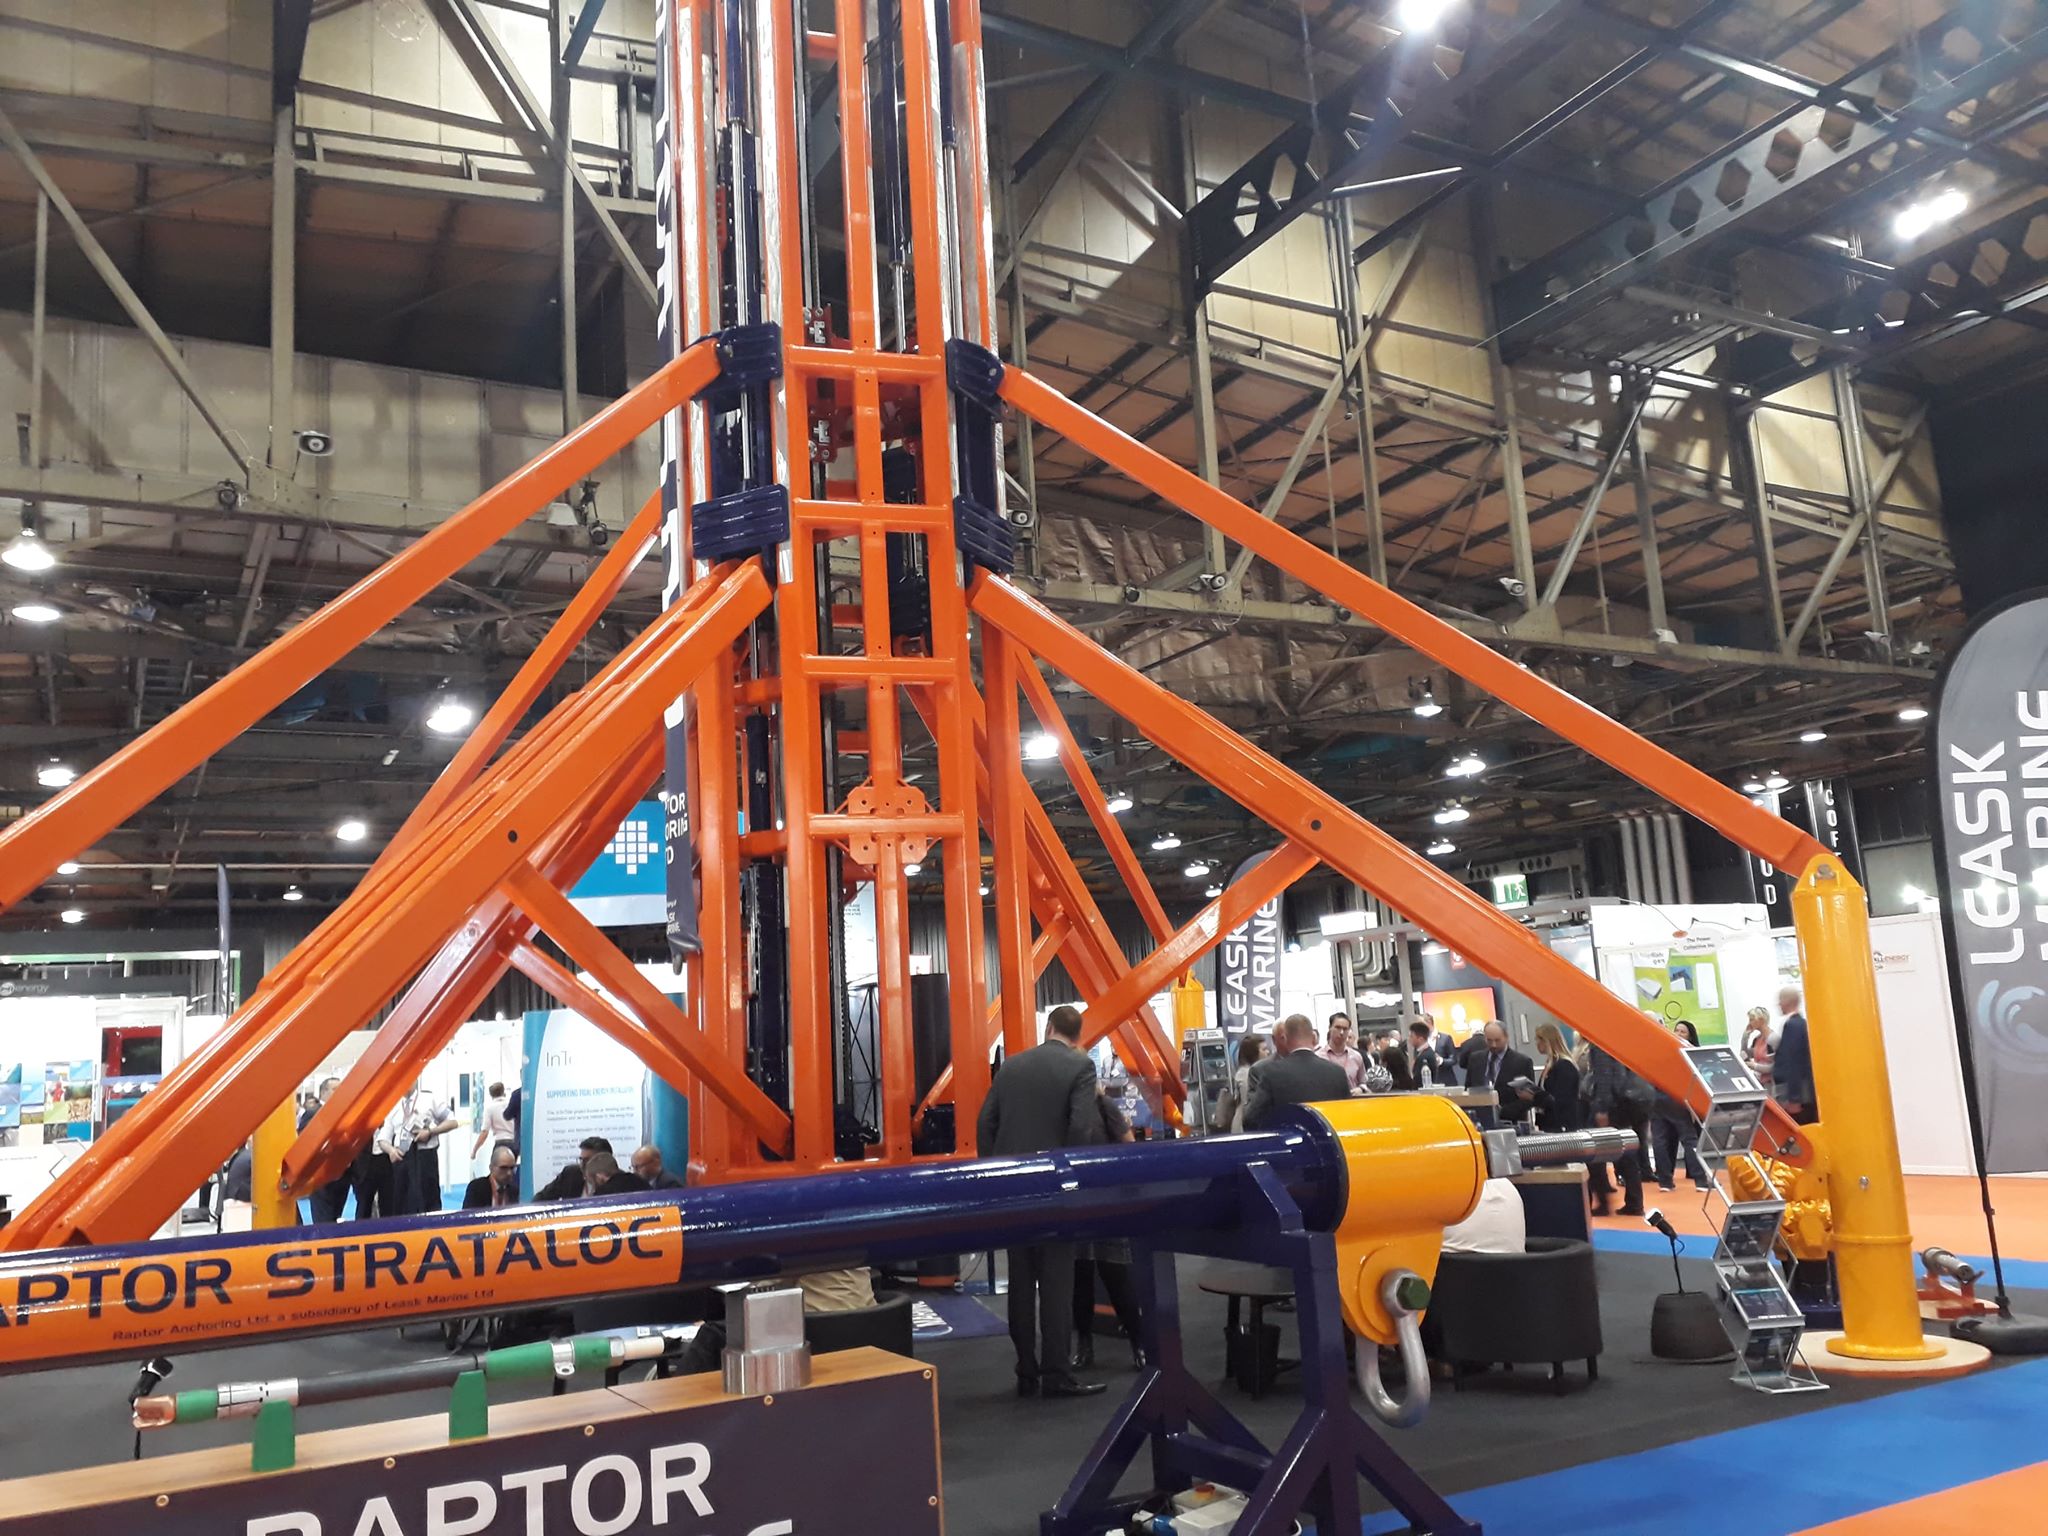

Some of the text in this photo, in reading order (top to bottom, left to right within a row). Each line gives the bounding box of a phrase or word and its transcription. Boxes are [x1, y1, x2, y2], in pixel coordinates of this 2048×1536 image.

[1950, 740, 2025, 965] LEASK
[1226, 920, 1249, 1034] LEASK
[1251, 897, 1278, 1035] MARINE
[265, 1213, 665, 1299] STRATALOC
[169, 1317, 242, 1335] Anchoring
[291, 1301, 362, 1320] subsidiary
[366, 1301, 379, 1313] of
[384, 1298, 421, 1311] Leask
[426, 1292, 470, 1304] Marine
